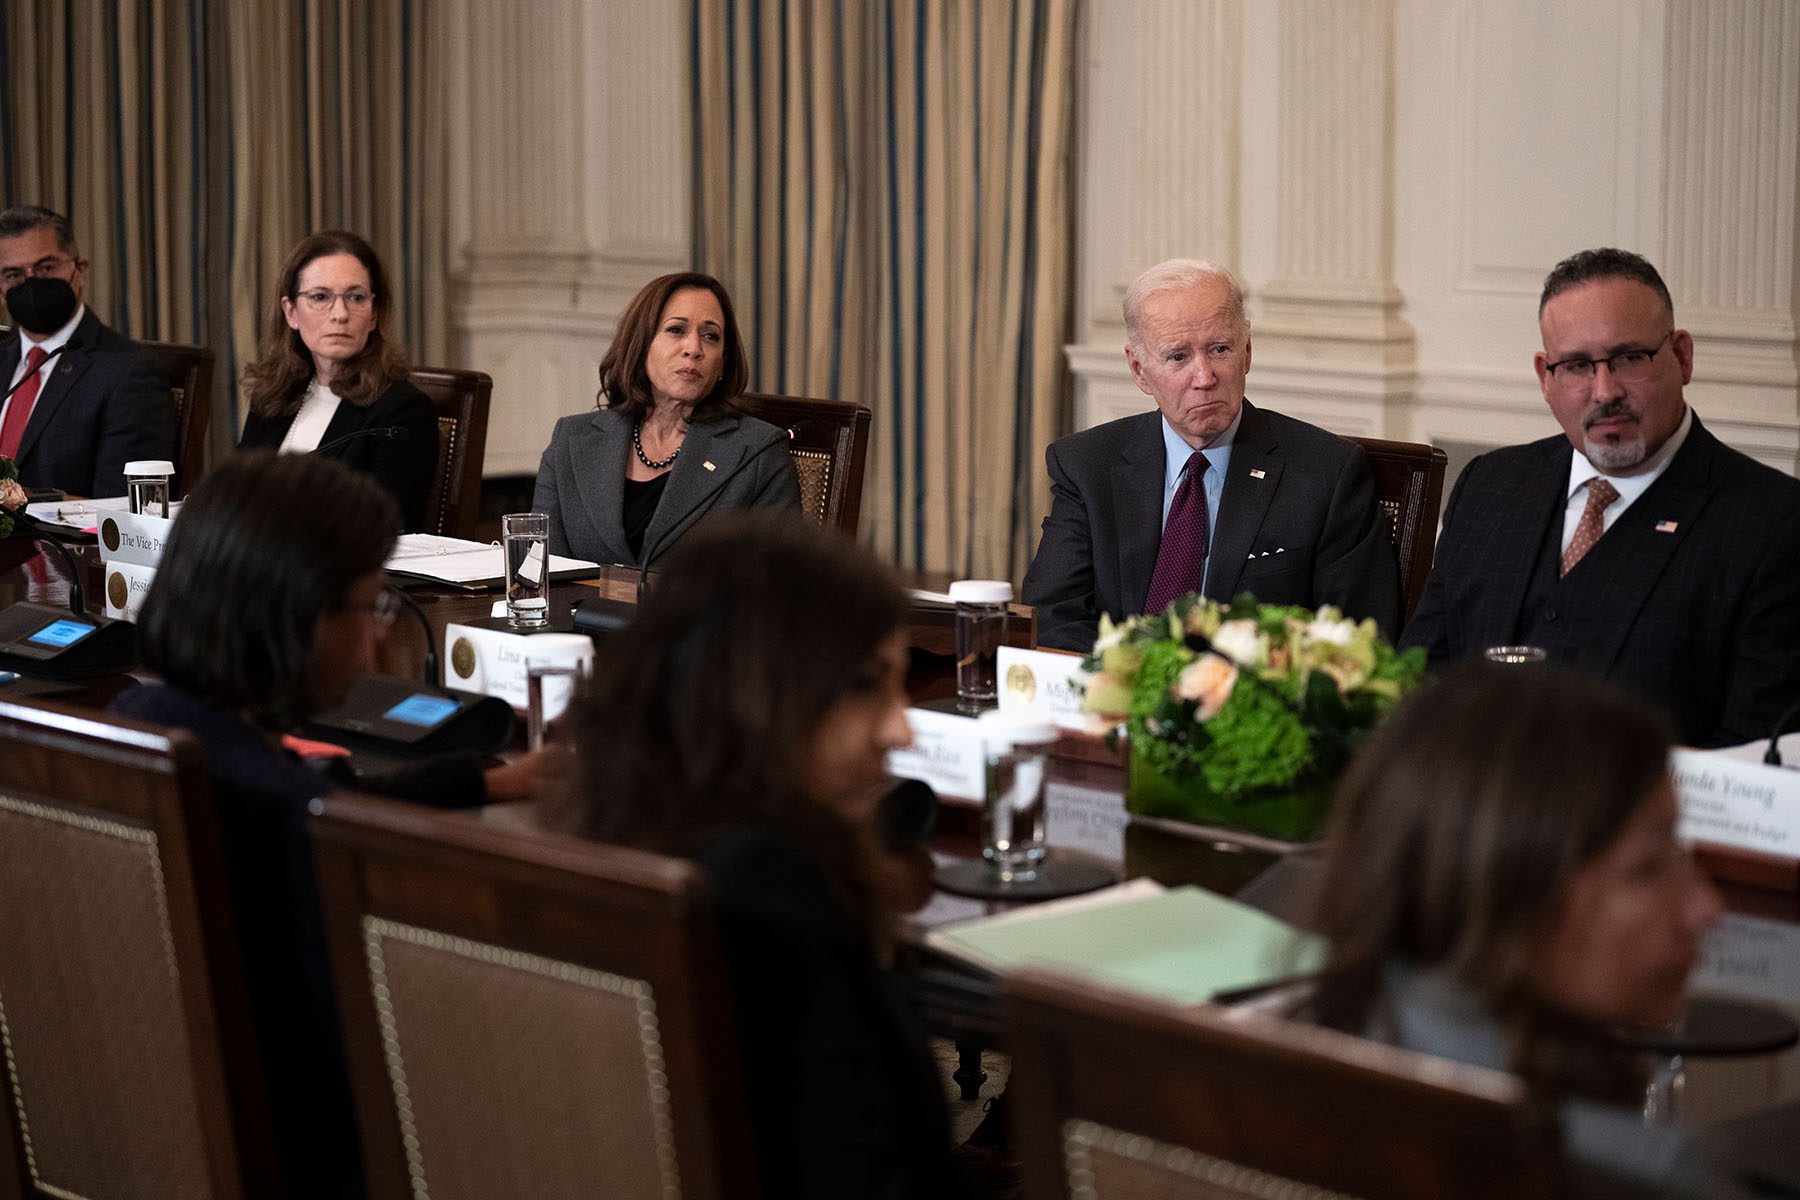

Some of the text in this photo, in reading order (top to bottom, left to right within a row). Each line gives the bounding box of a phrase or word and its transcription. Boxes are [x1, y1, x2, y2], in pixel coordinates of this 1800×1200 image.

[121, 533, 135, 548] The
[136, 535, 152, 551] Vice
[1722, 772, 1776, 809] Young
